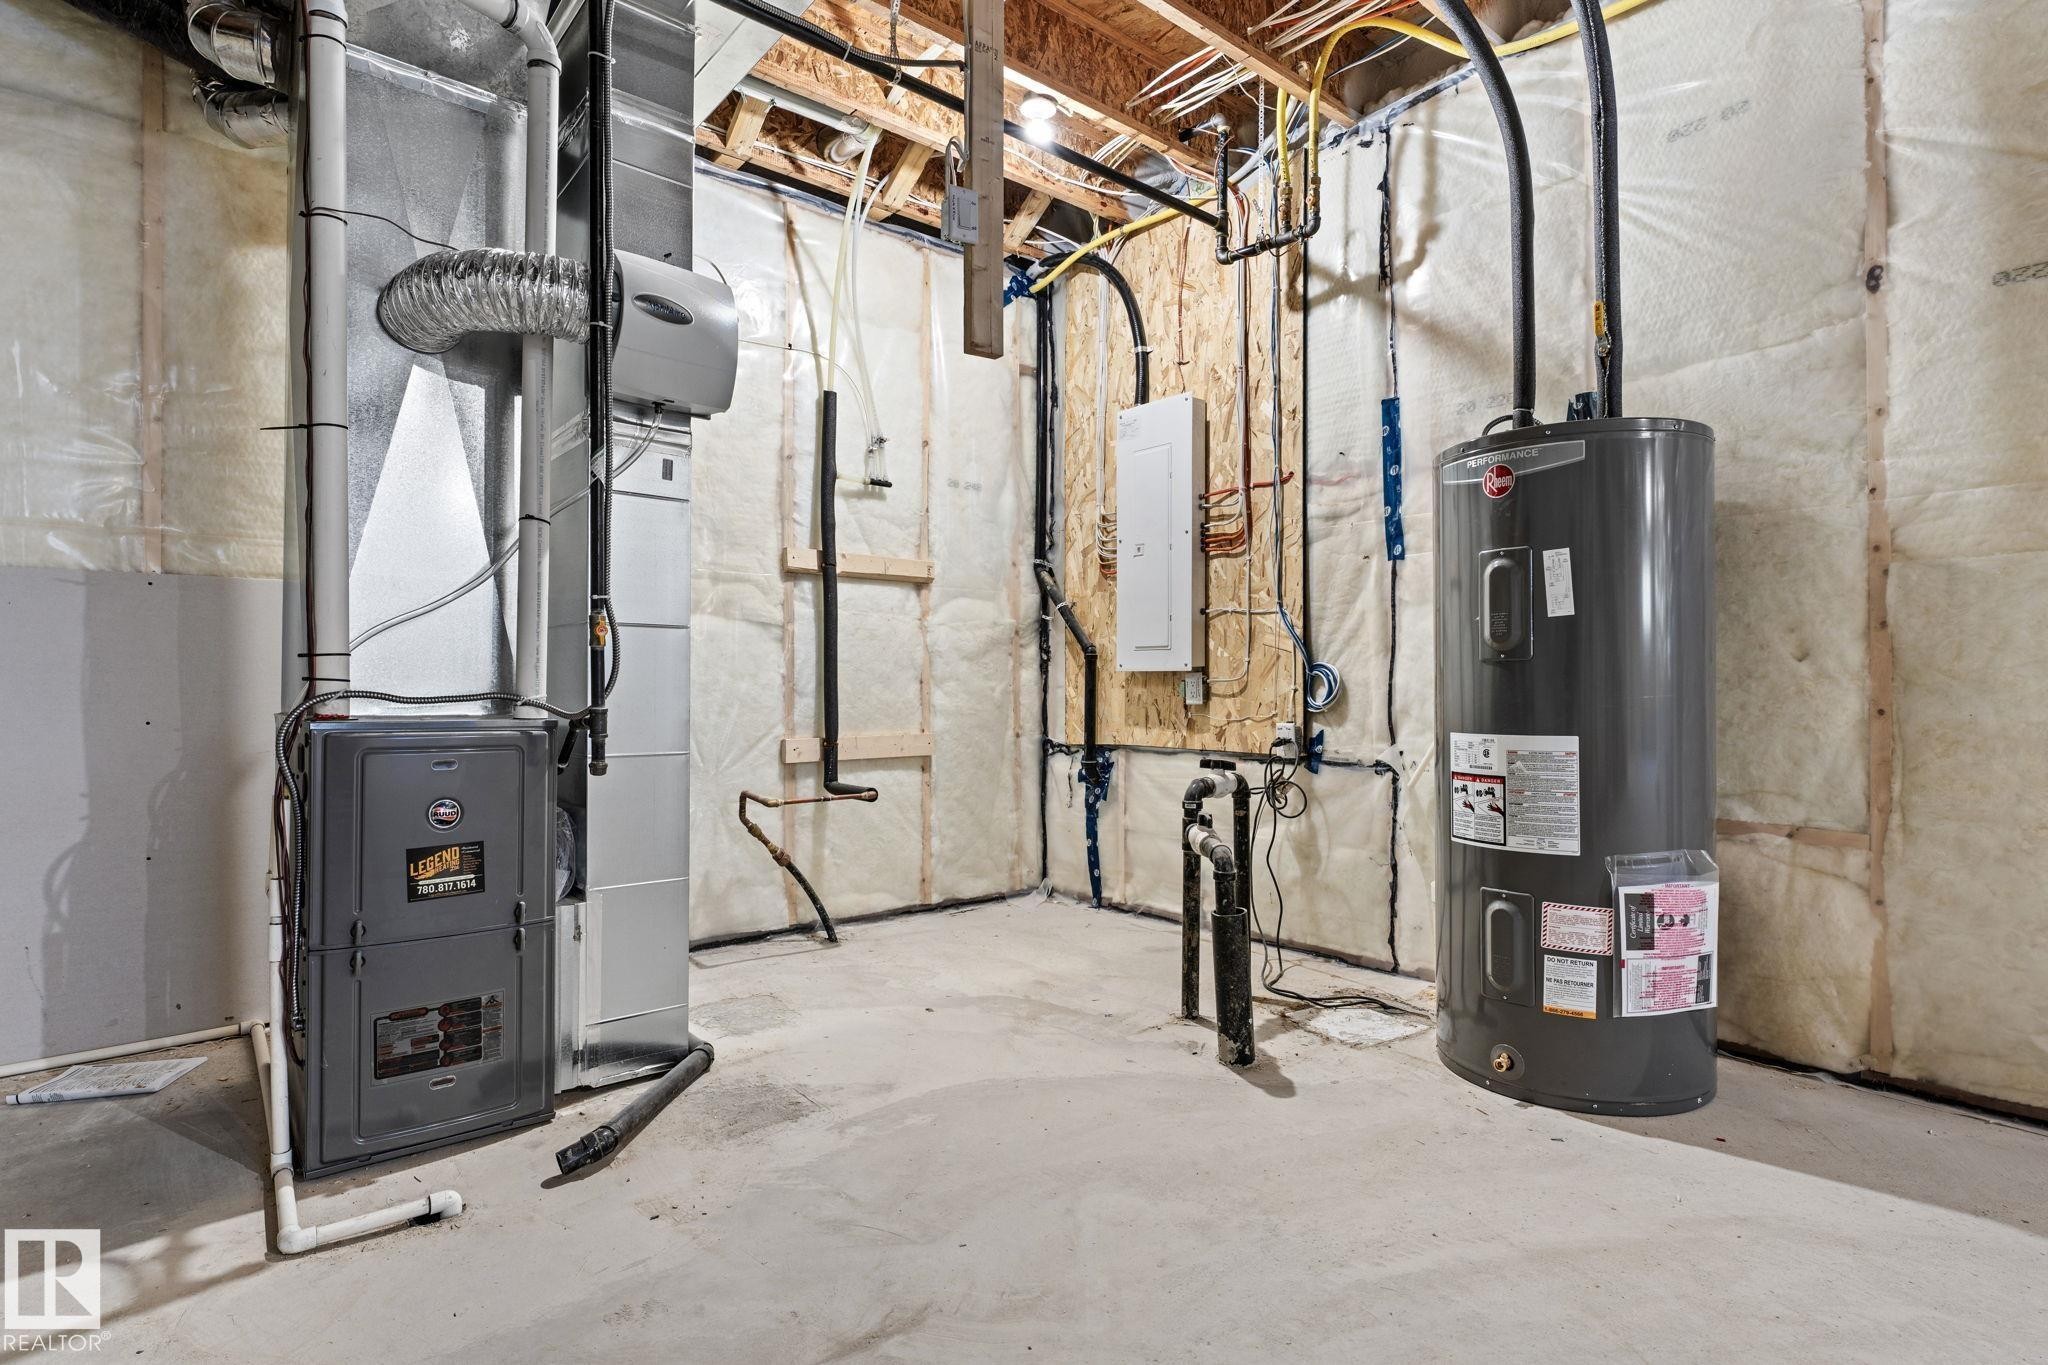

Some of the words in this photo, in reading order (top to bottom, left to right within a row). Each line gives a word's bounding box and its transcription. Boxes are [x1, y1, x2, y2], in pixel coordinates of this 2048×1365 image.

[1467, 448, 1538, 468] PERFORMANCE
[1486, 466, 1512, 492] Rheem
[433, 810, 457, 818] RUUD
[410, 846, 460, 877] LEGEND
[434, 859, 460, 873] HEATING
[417, 879, 477, 895] 780.817.1614
[1563, 980, 1594, 988] RETOURNER
